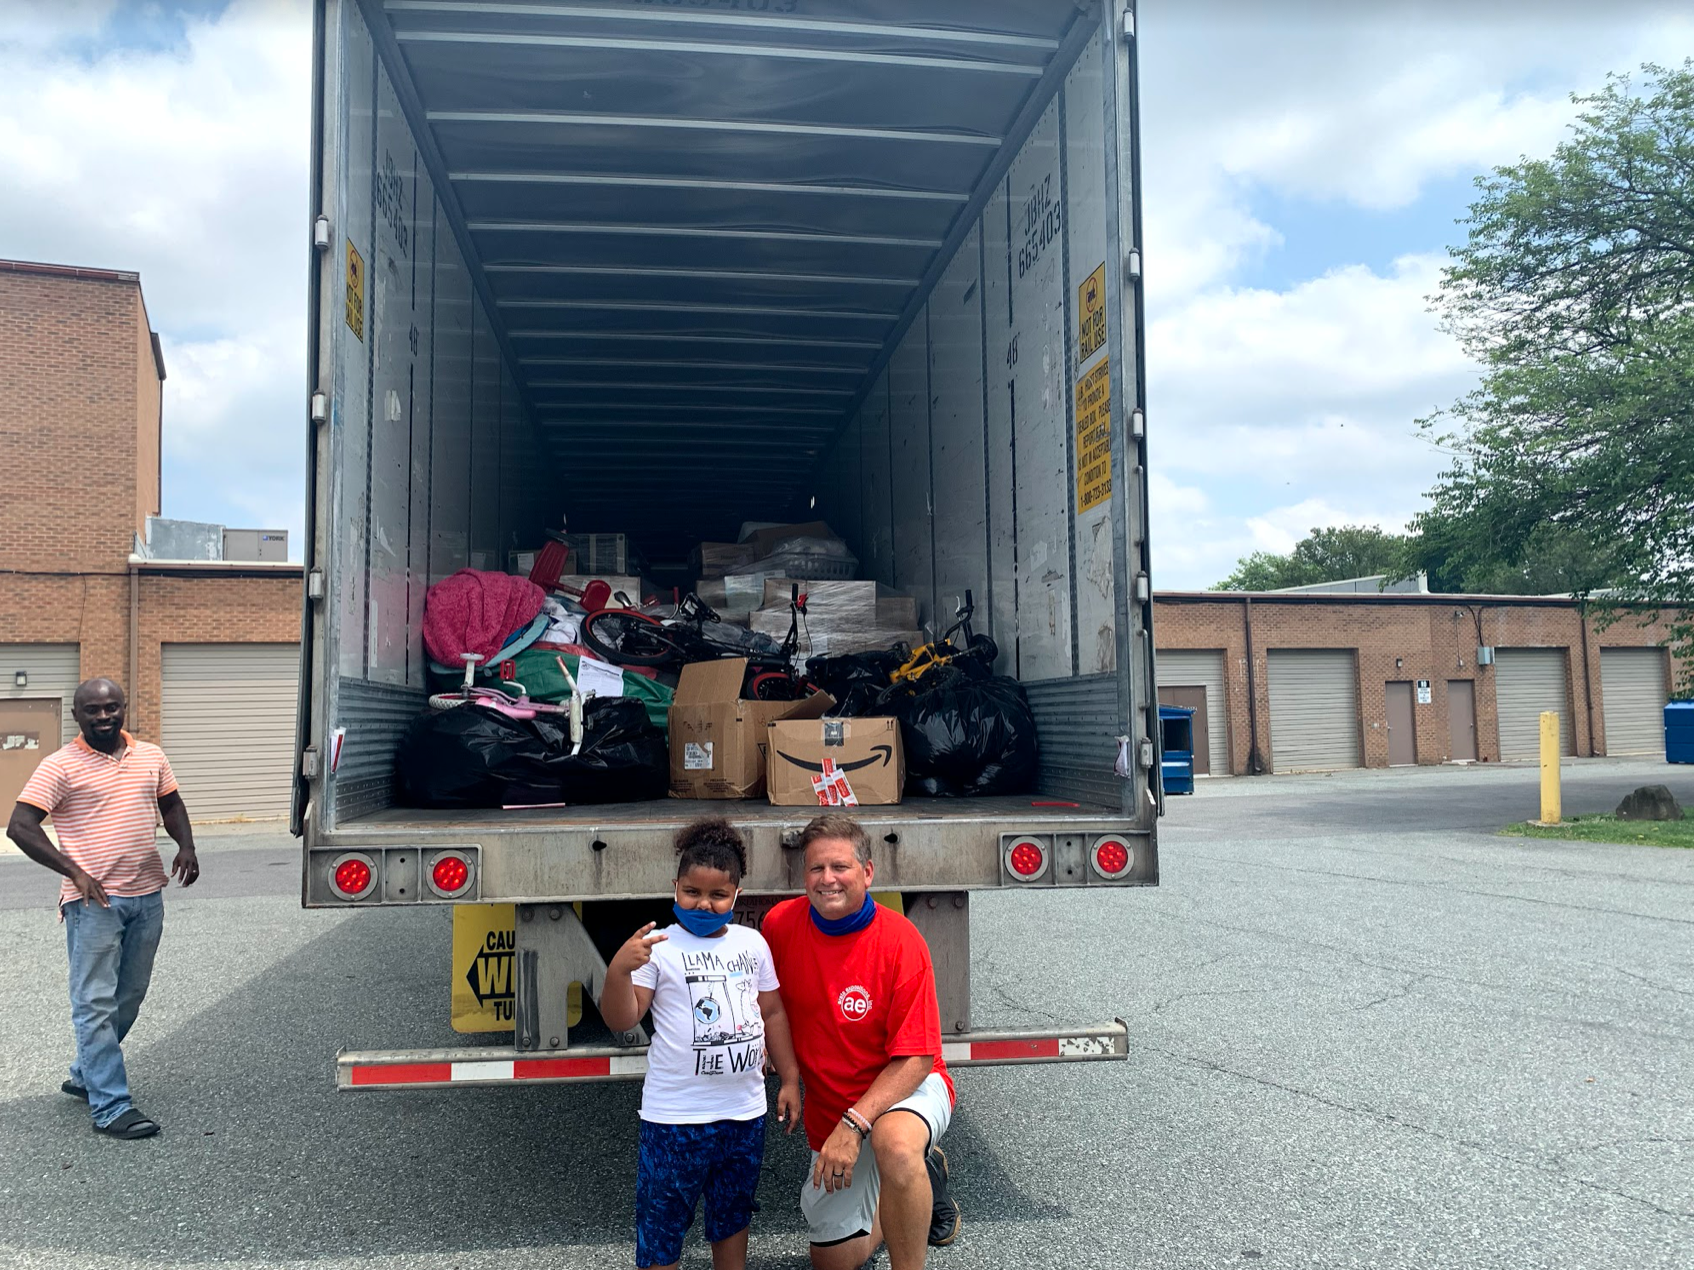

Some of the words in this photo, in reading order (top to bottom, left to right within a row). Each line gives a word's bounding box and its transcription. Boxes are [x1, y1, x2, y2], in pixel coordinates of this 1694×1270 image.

[1024, 173, 1051, 236] JBHZ
[1019, 200, 1060, 279] 665403
[1082, 316, 1091, 341] NOT
[1093, 306, 1104, 330] FOR
[1081, 337, 1092, 361] RAIL
[1094, 324, 1105, 348] USE
[1093, 437, 1111, 462] ACCEPTABL
[681, 951, 725, 972] LLAMA
[844, 996, 867, 1014] ae
[692, 1047, 724, 1076] THE
